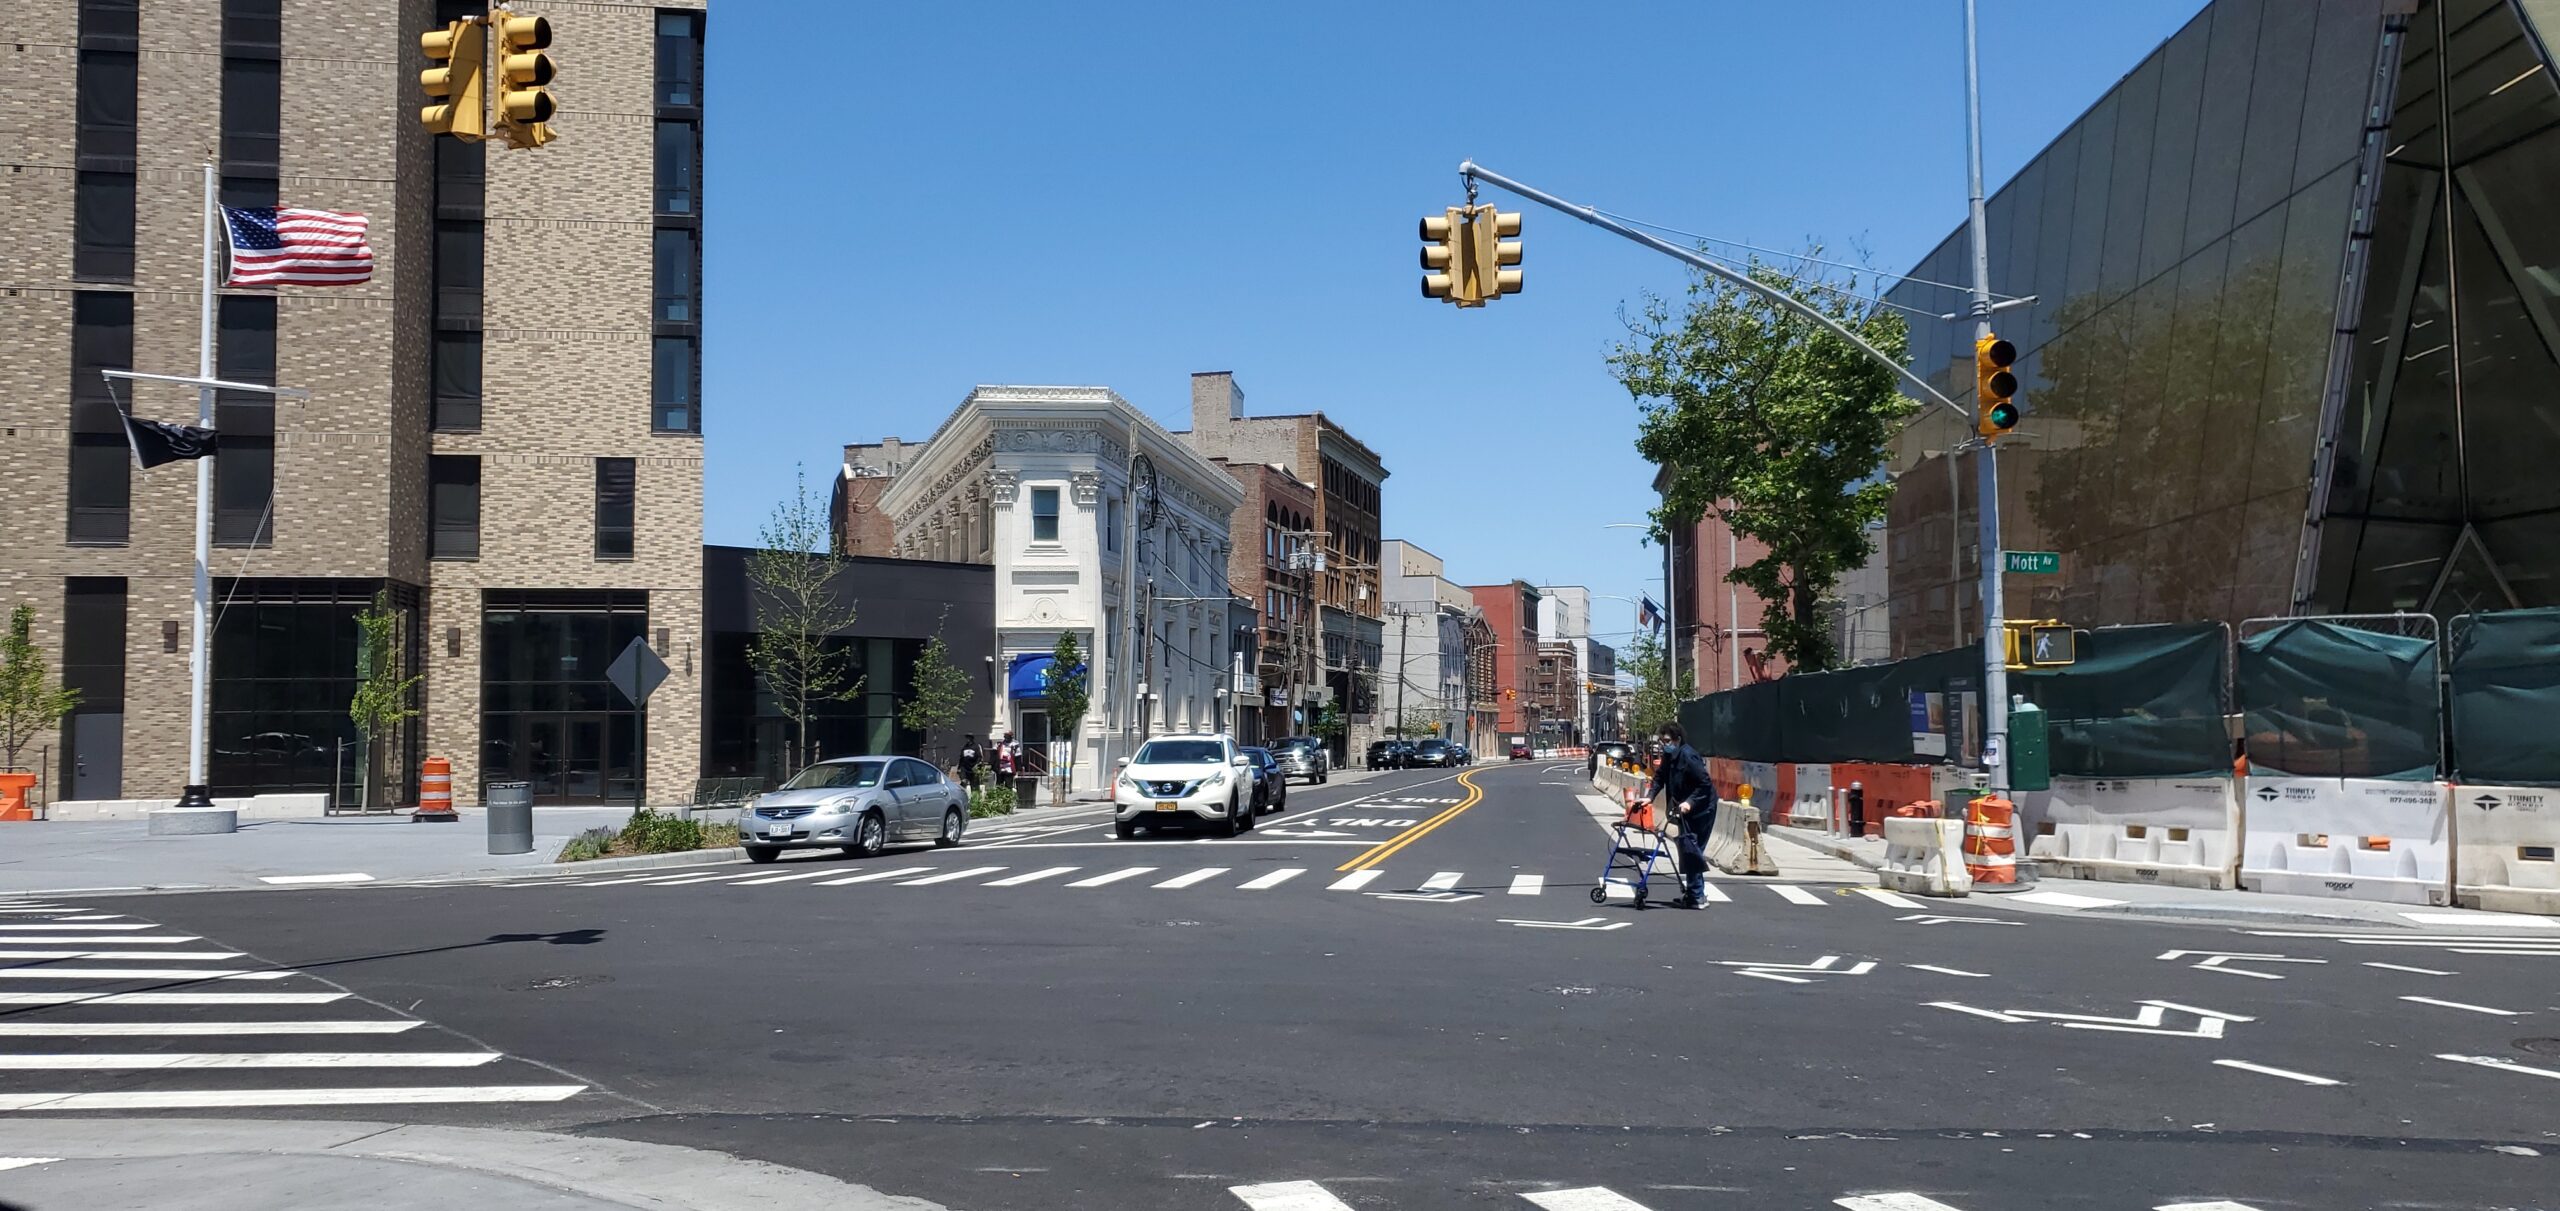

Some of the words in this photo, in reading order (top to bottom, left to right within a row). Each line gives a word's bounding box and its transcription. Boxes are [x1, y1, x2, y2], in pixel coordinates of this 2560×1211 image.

[2011, 555, 2038, 570] Mott
[2043, 556, 2053, 565] Av
[2507, 794, 2544, 802] TRINITY
[1278, 818, 1419, 827] ONLY
